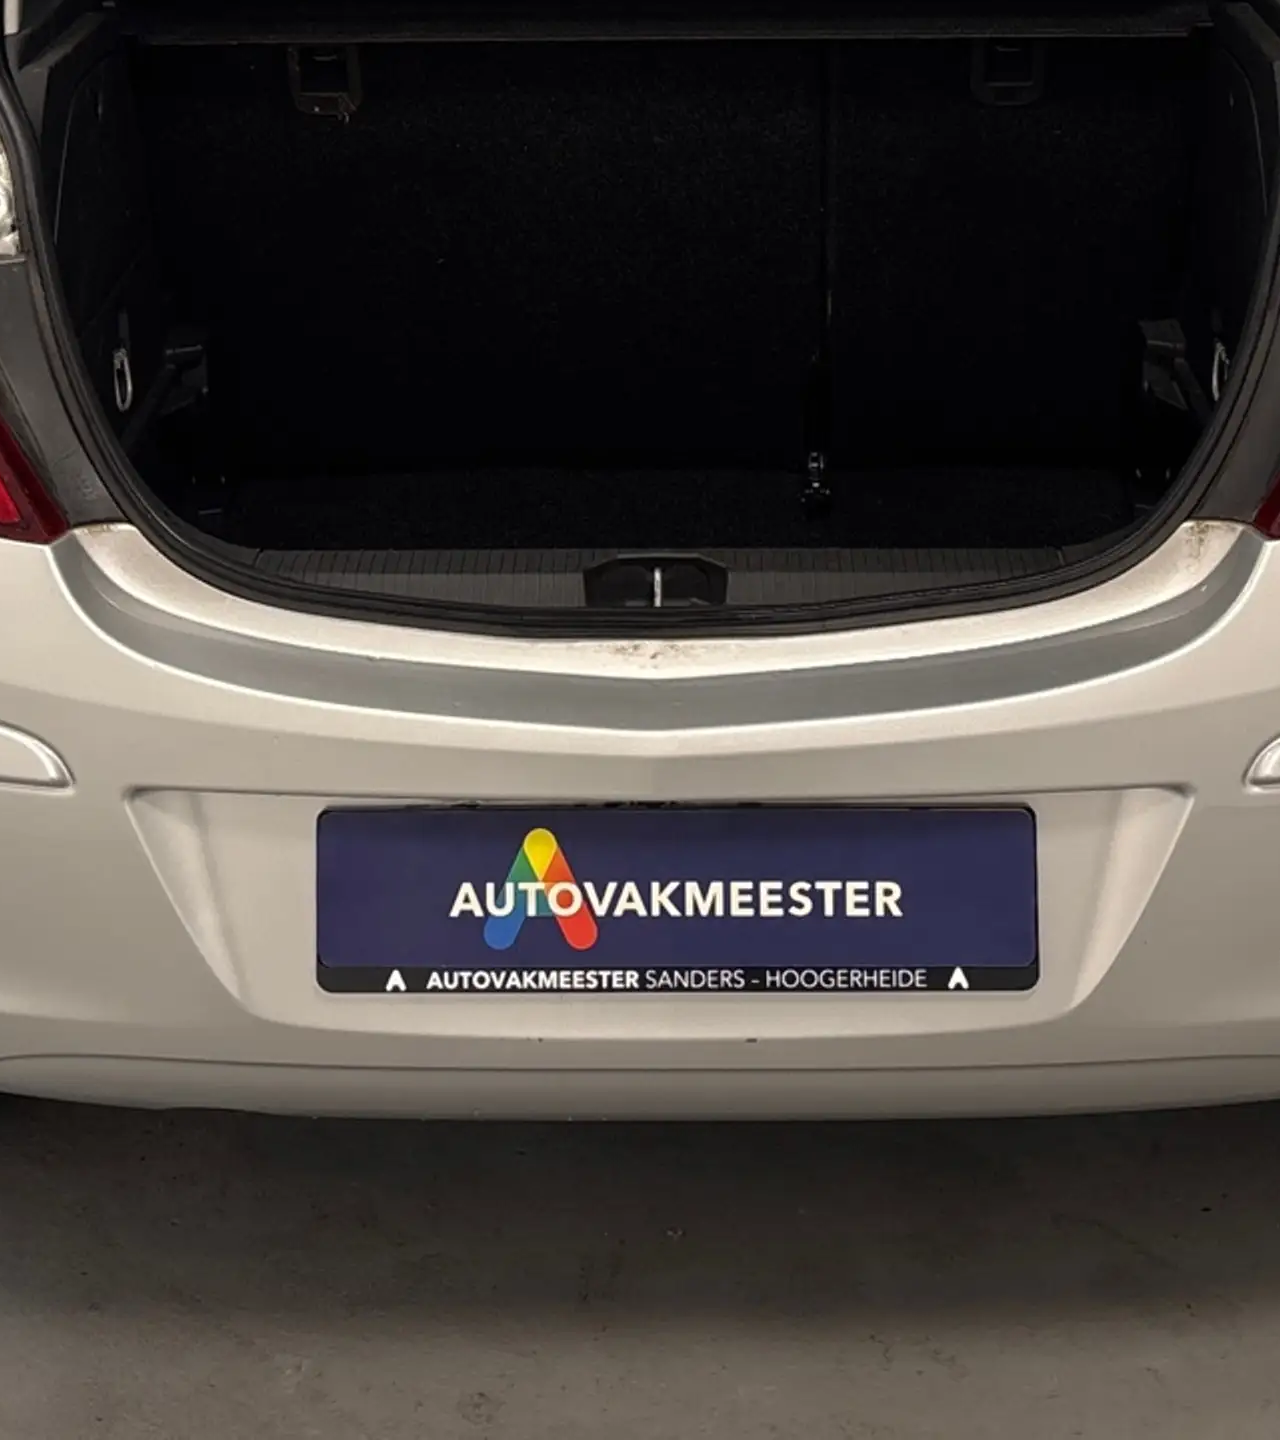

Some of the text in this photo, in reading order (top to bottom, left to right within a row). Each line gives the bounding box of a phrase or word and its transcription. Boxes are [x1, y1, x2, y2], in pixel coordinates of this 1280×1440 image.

[450, 881, 903, 917] AUTOVAKMEESTER
[426, 968, 639, 990] AUTOVAKMEESTER
[645, 968, 745, 989] SANDERS
[765, 967, 927, 989] HOOGERHEIDE
